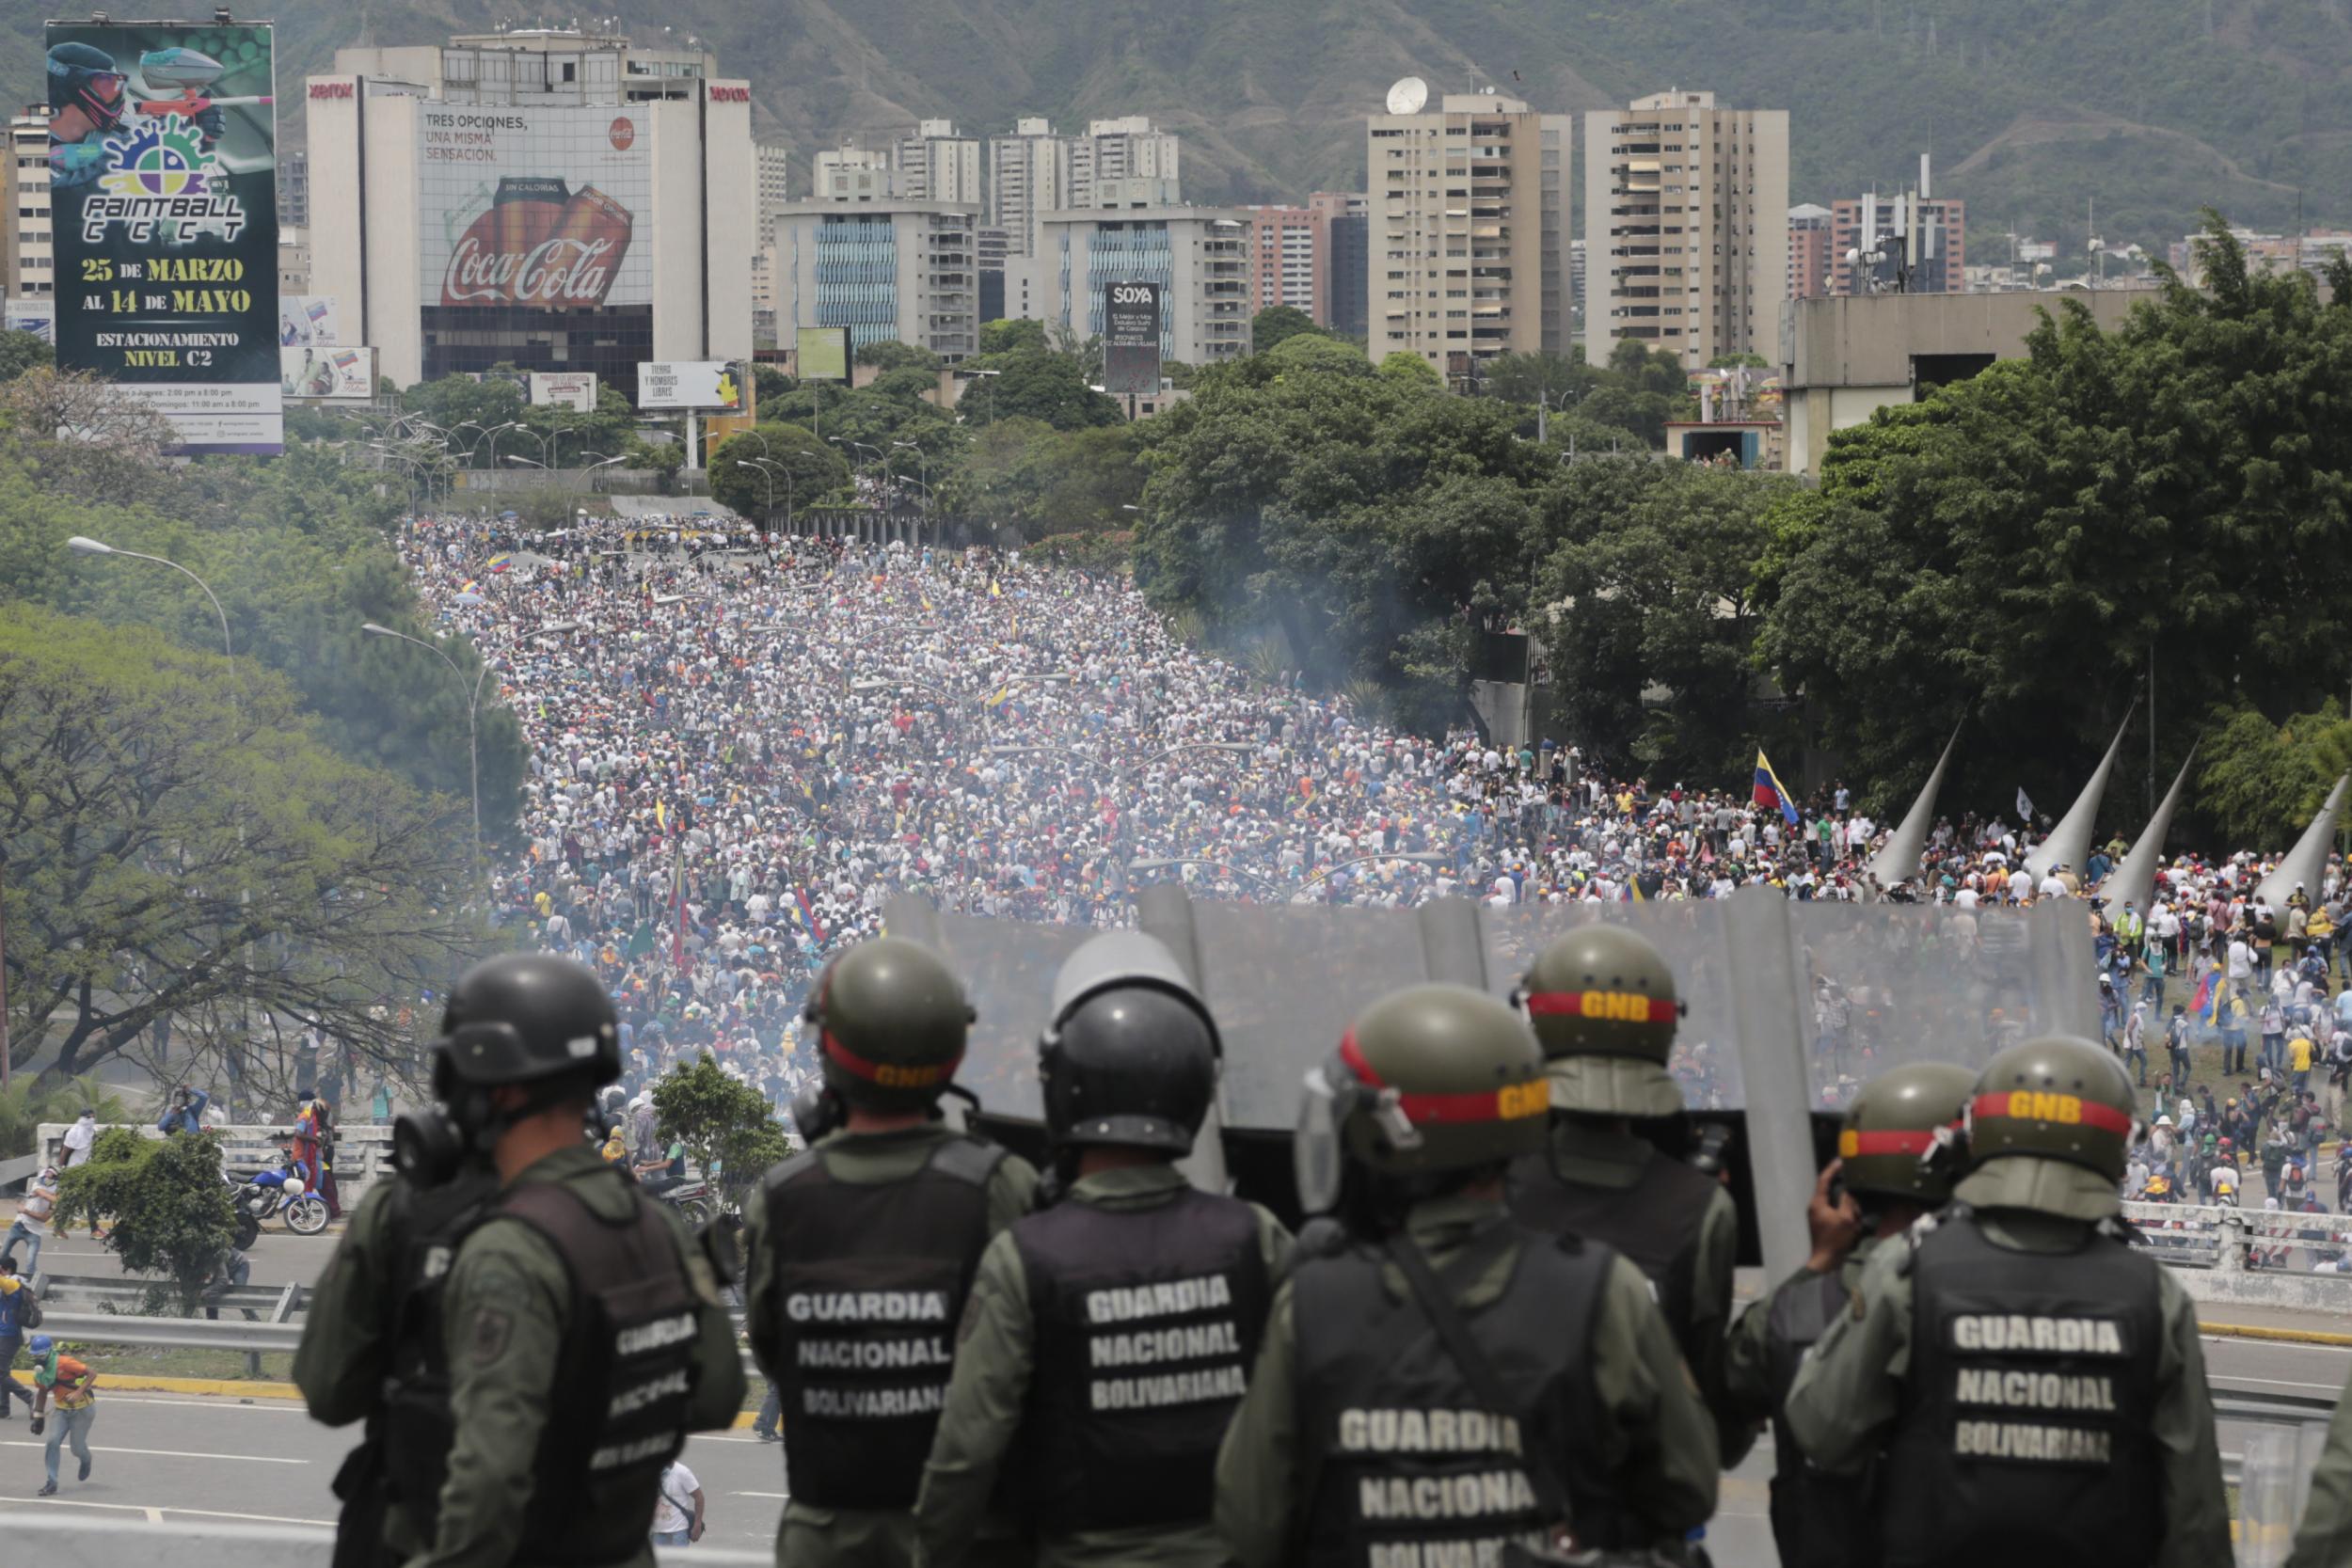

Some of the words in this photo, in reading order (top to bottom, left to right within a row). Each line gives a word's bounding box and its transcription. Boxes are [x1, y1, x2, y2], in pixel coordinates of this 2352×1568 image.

[309, 83, 354, 99] xerox
[709, 86, 750, 102] xerox
[426, 114, 454, 127] TRES
[458, 115, 528, 131] OPCIONES,
[426, 132, 450, 143] UNA
[454, 133, 492, 145] MISMA
[81, 259, 113, 281] 25
[119, 263, 141, 278] DE
[146, 258, 244, 281] MARZO
[447, 237, 614, 301] Coca-Cola
[83, 295, 104, 310] AL
[111, 290, 138, 313] 14
[145, 295, 167, 310] DE
[171, 289, 251, 313] MAYO
[1114, 287, 1152, 304] SOYA
[96, 332, 239, 347] ESTACIONAMIENTO
[124, 350, 181, 368] NIVEL
[186, 350, 213, 367] C2
[184, 390, 196, 399] pm
[221, 390, 232, 399] pm
[192, 400, 211, 408] 11:00
[248, 402, 260, 410] pm
[1581, 990, 1650, 1022] GNB
[874, 1063, 941, 1087] GNB
[2008, 1090, 2081, 1124] GNB
[787, 1291, 945, 1321] GUARDIA
[1087, 1274, 1231, 1324] GUARDIA
[1090, 1321, 1240, 1368] NACIONAL
[1954, 1314, 2122, 1354] GUARDIA
[798, 1338, 951, 1369] NACIONAL
[803, 1386, 945, 1415] BOLIVARIAN
[1091, 1364, 1247, 1410] BOLIVARIANA
[1956, 1368, 2116, 1410] NACIONAL
[1339, 1408, 1523, 1456] GUARDIA
[1359, 1469, 1538, 1519] NACIONA
